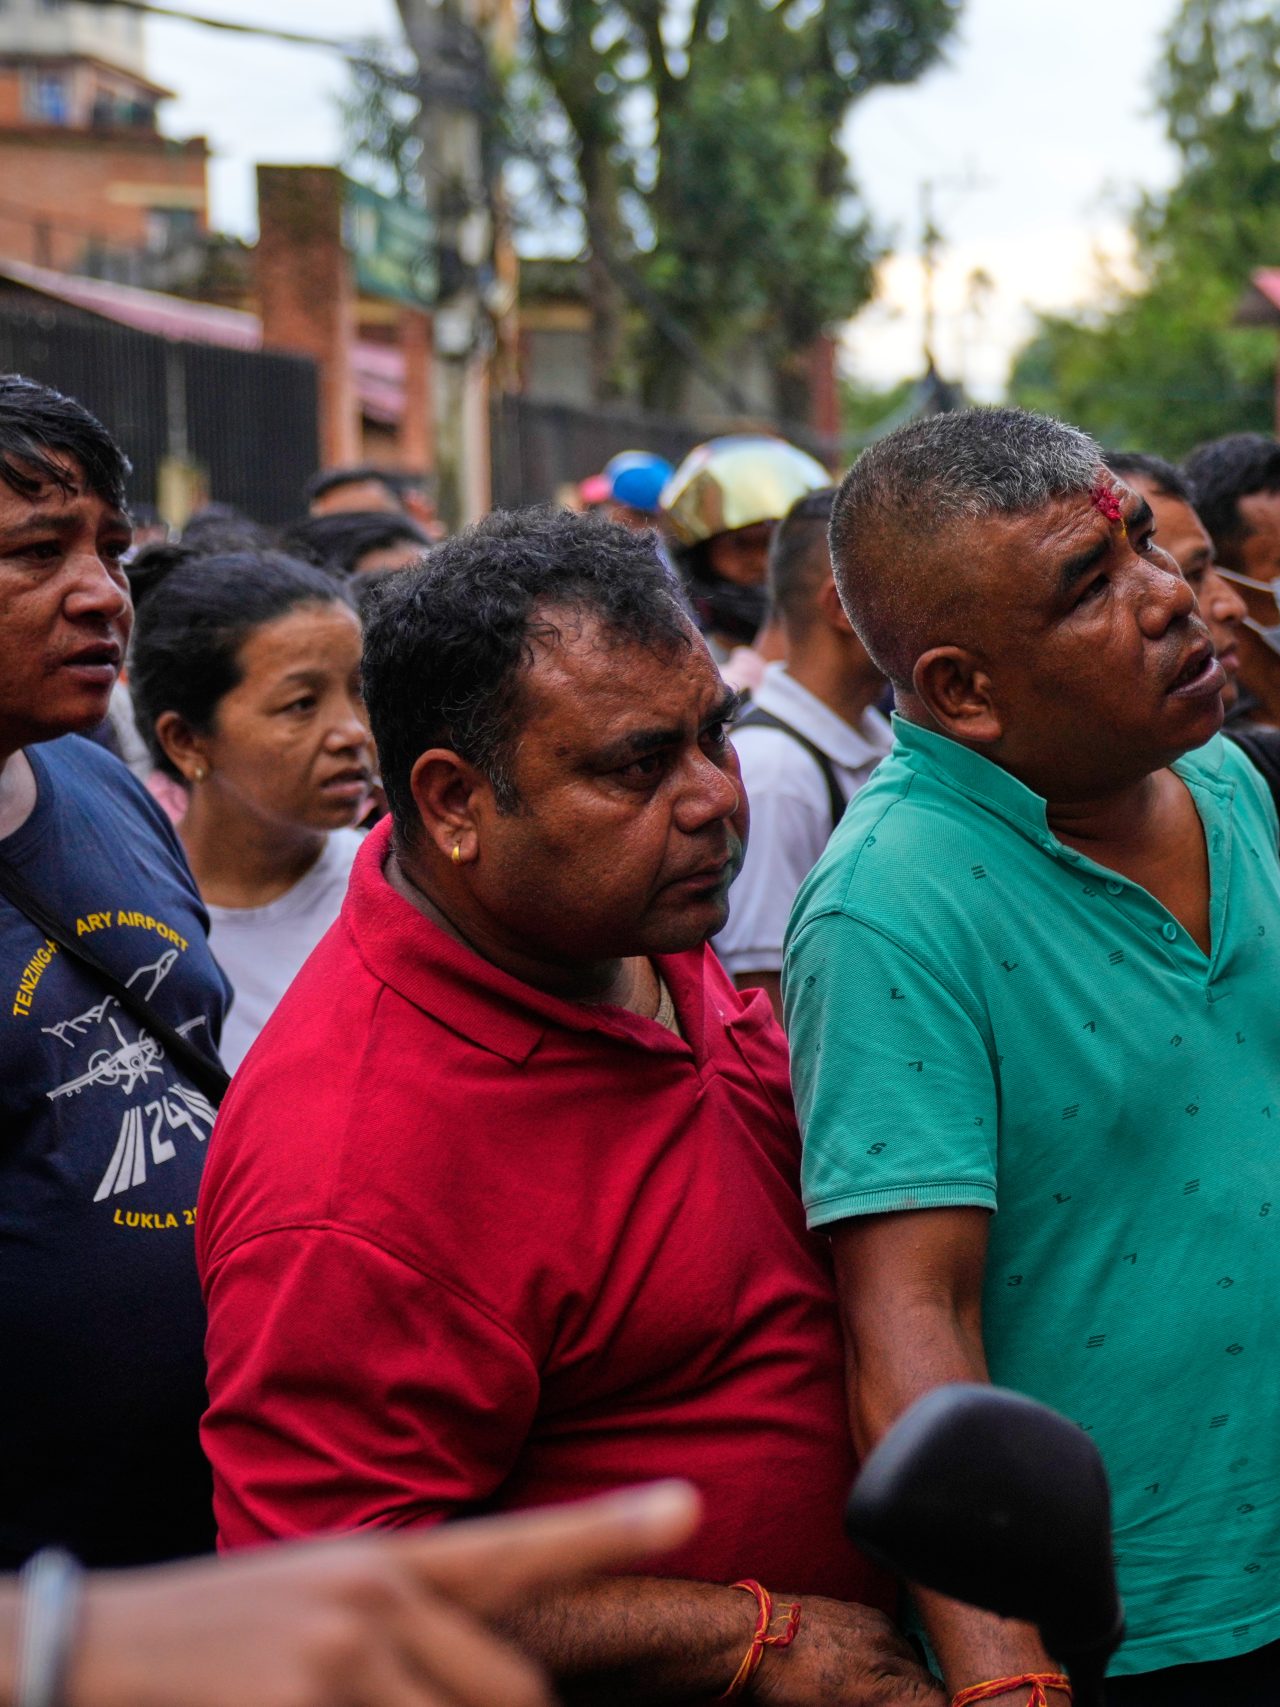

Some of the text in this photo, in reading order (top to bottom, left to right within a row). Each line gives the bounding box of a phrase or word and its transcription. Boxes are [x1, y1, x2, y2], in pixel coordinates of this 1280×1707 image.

[117, 910, 189, 952] AIRPORT
[144, 1095, 206, 1165] 24
[113, 1208, 179, 1229] LUKLA
